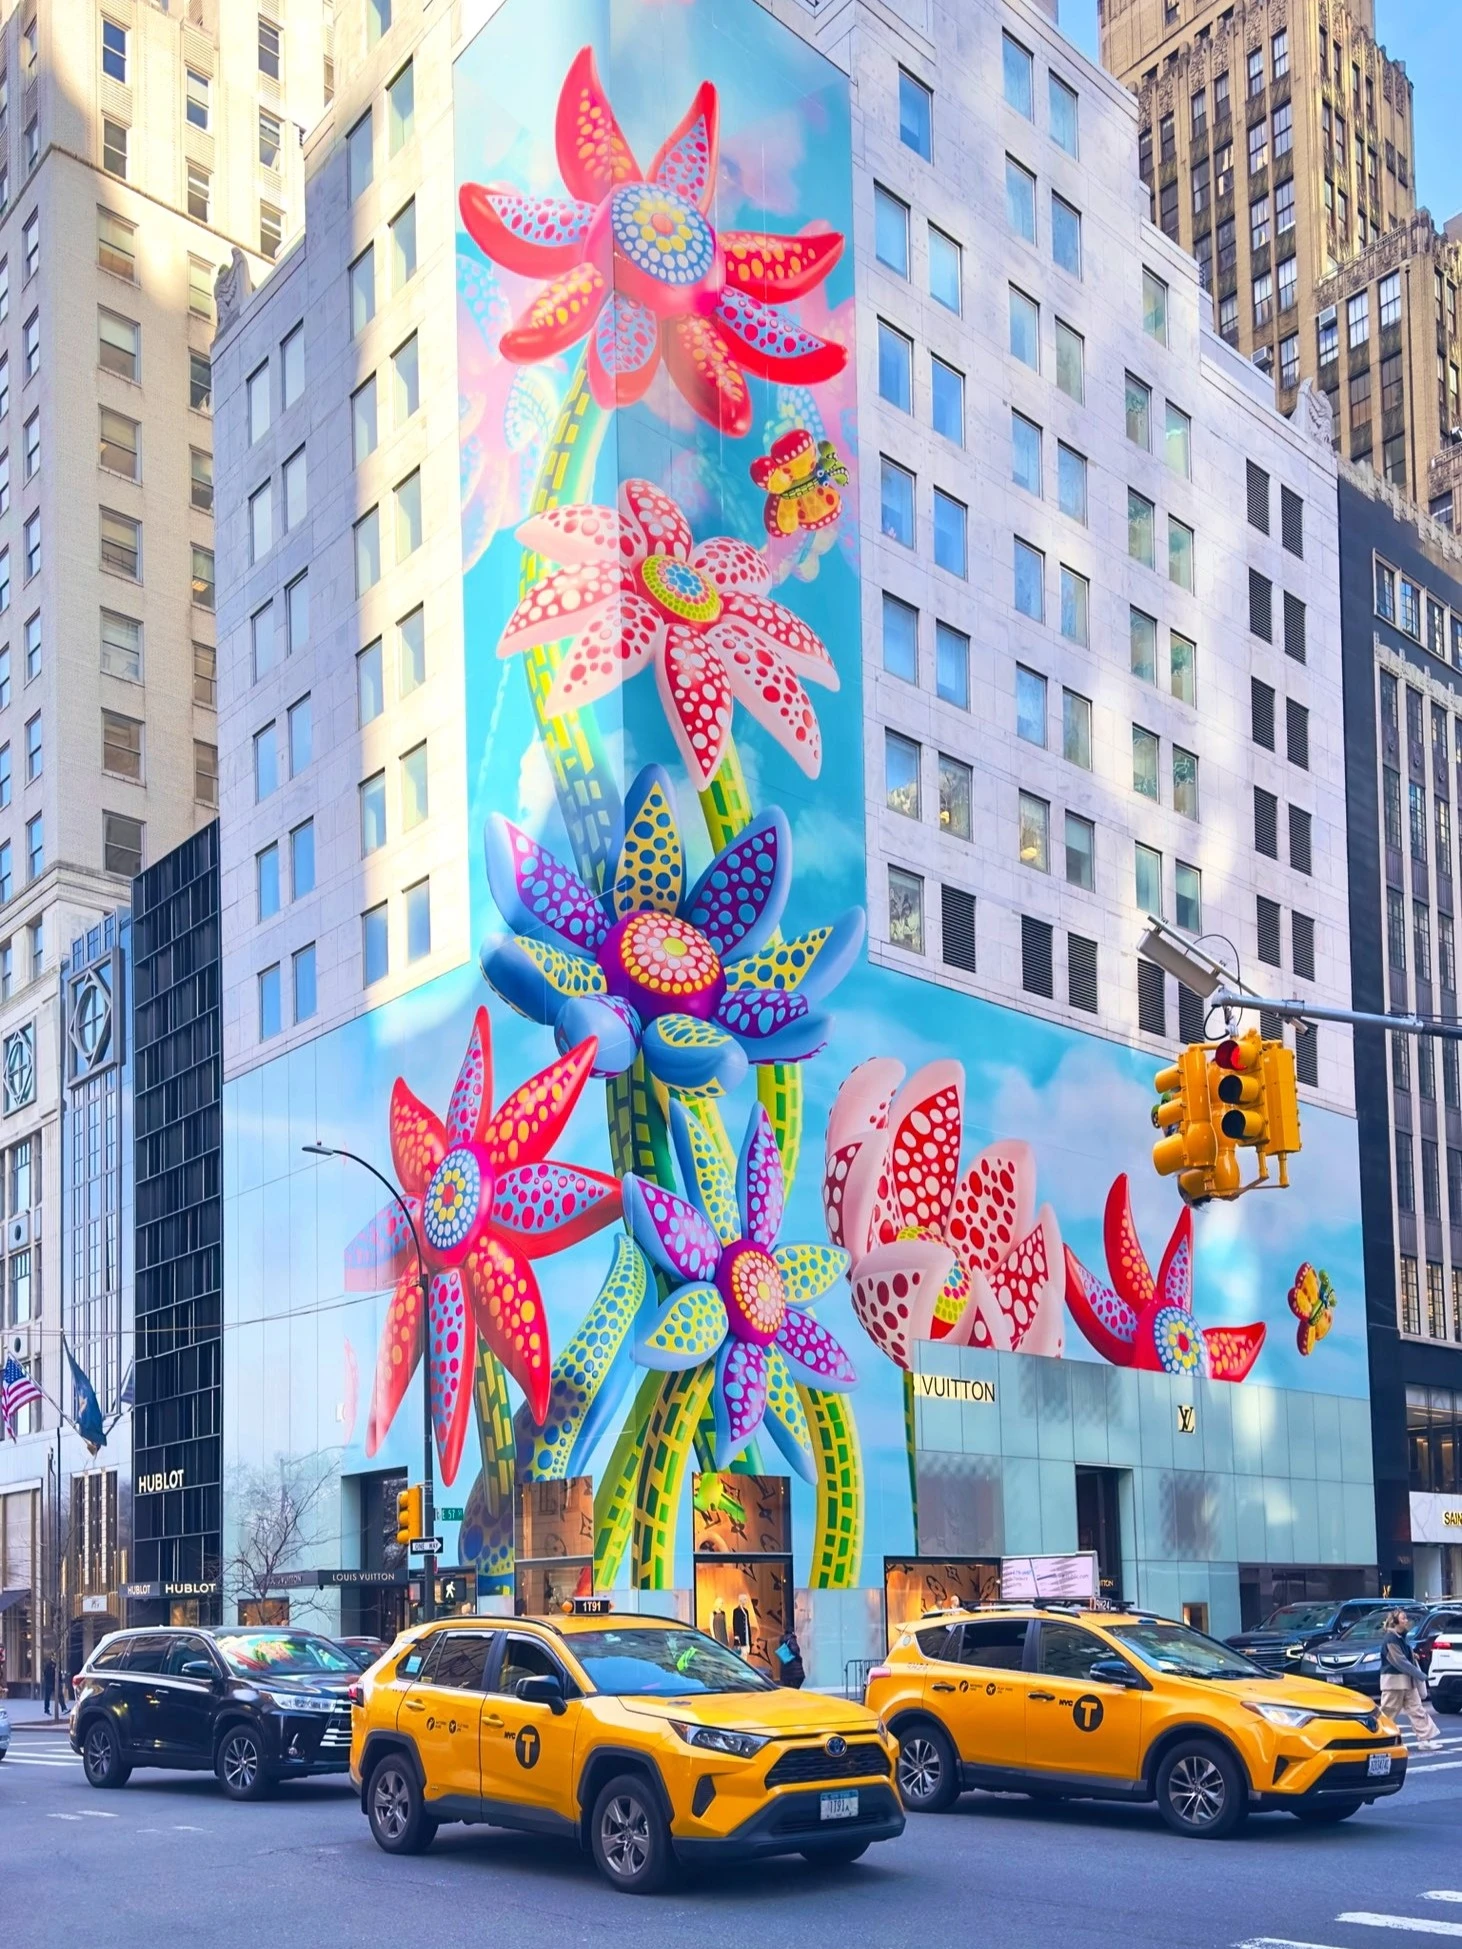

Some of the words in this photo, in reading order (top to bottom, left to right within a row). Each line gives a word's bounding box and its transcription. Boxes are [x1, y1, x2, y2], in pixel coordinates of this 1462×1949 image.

[921, 1375, 996, 1403] VUITTON
[138, 1469, 185, 1494] HUBLOT
[414, 1543, 425, 1551] ONE
[428, 1541, 439, 1549] WAY
[332, 1573, 357, 1582] LOUIS
[359, 1572, 395, 1581] VUITTON
[127, 1584, 151, 1595] HUBLOT
[165, 1583, 216, 1594] HUBLOT
[583, 1601, 601, 1612] 1T91
[1059, 1699, 1073, 1707] NYC
[1081, 1701, 1098, 1728] T
[504, 1731, 516, 1739] NYC
[521, 1733, 536, 1764] T
